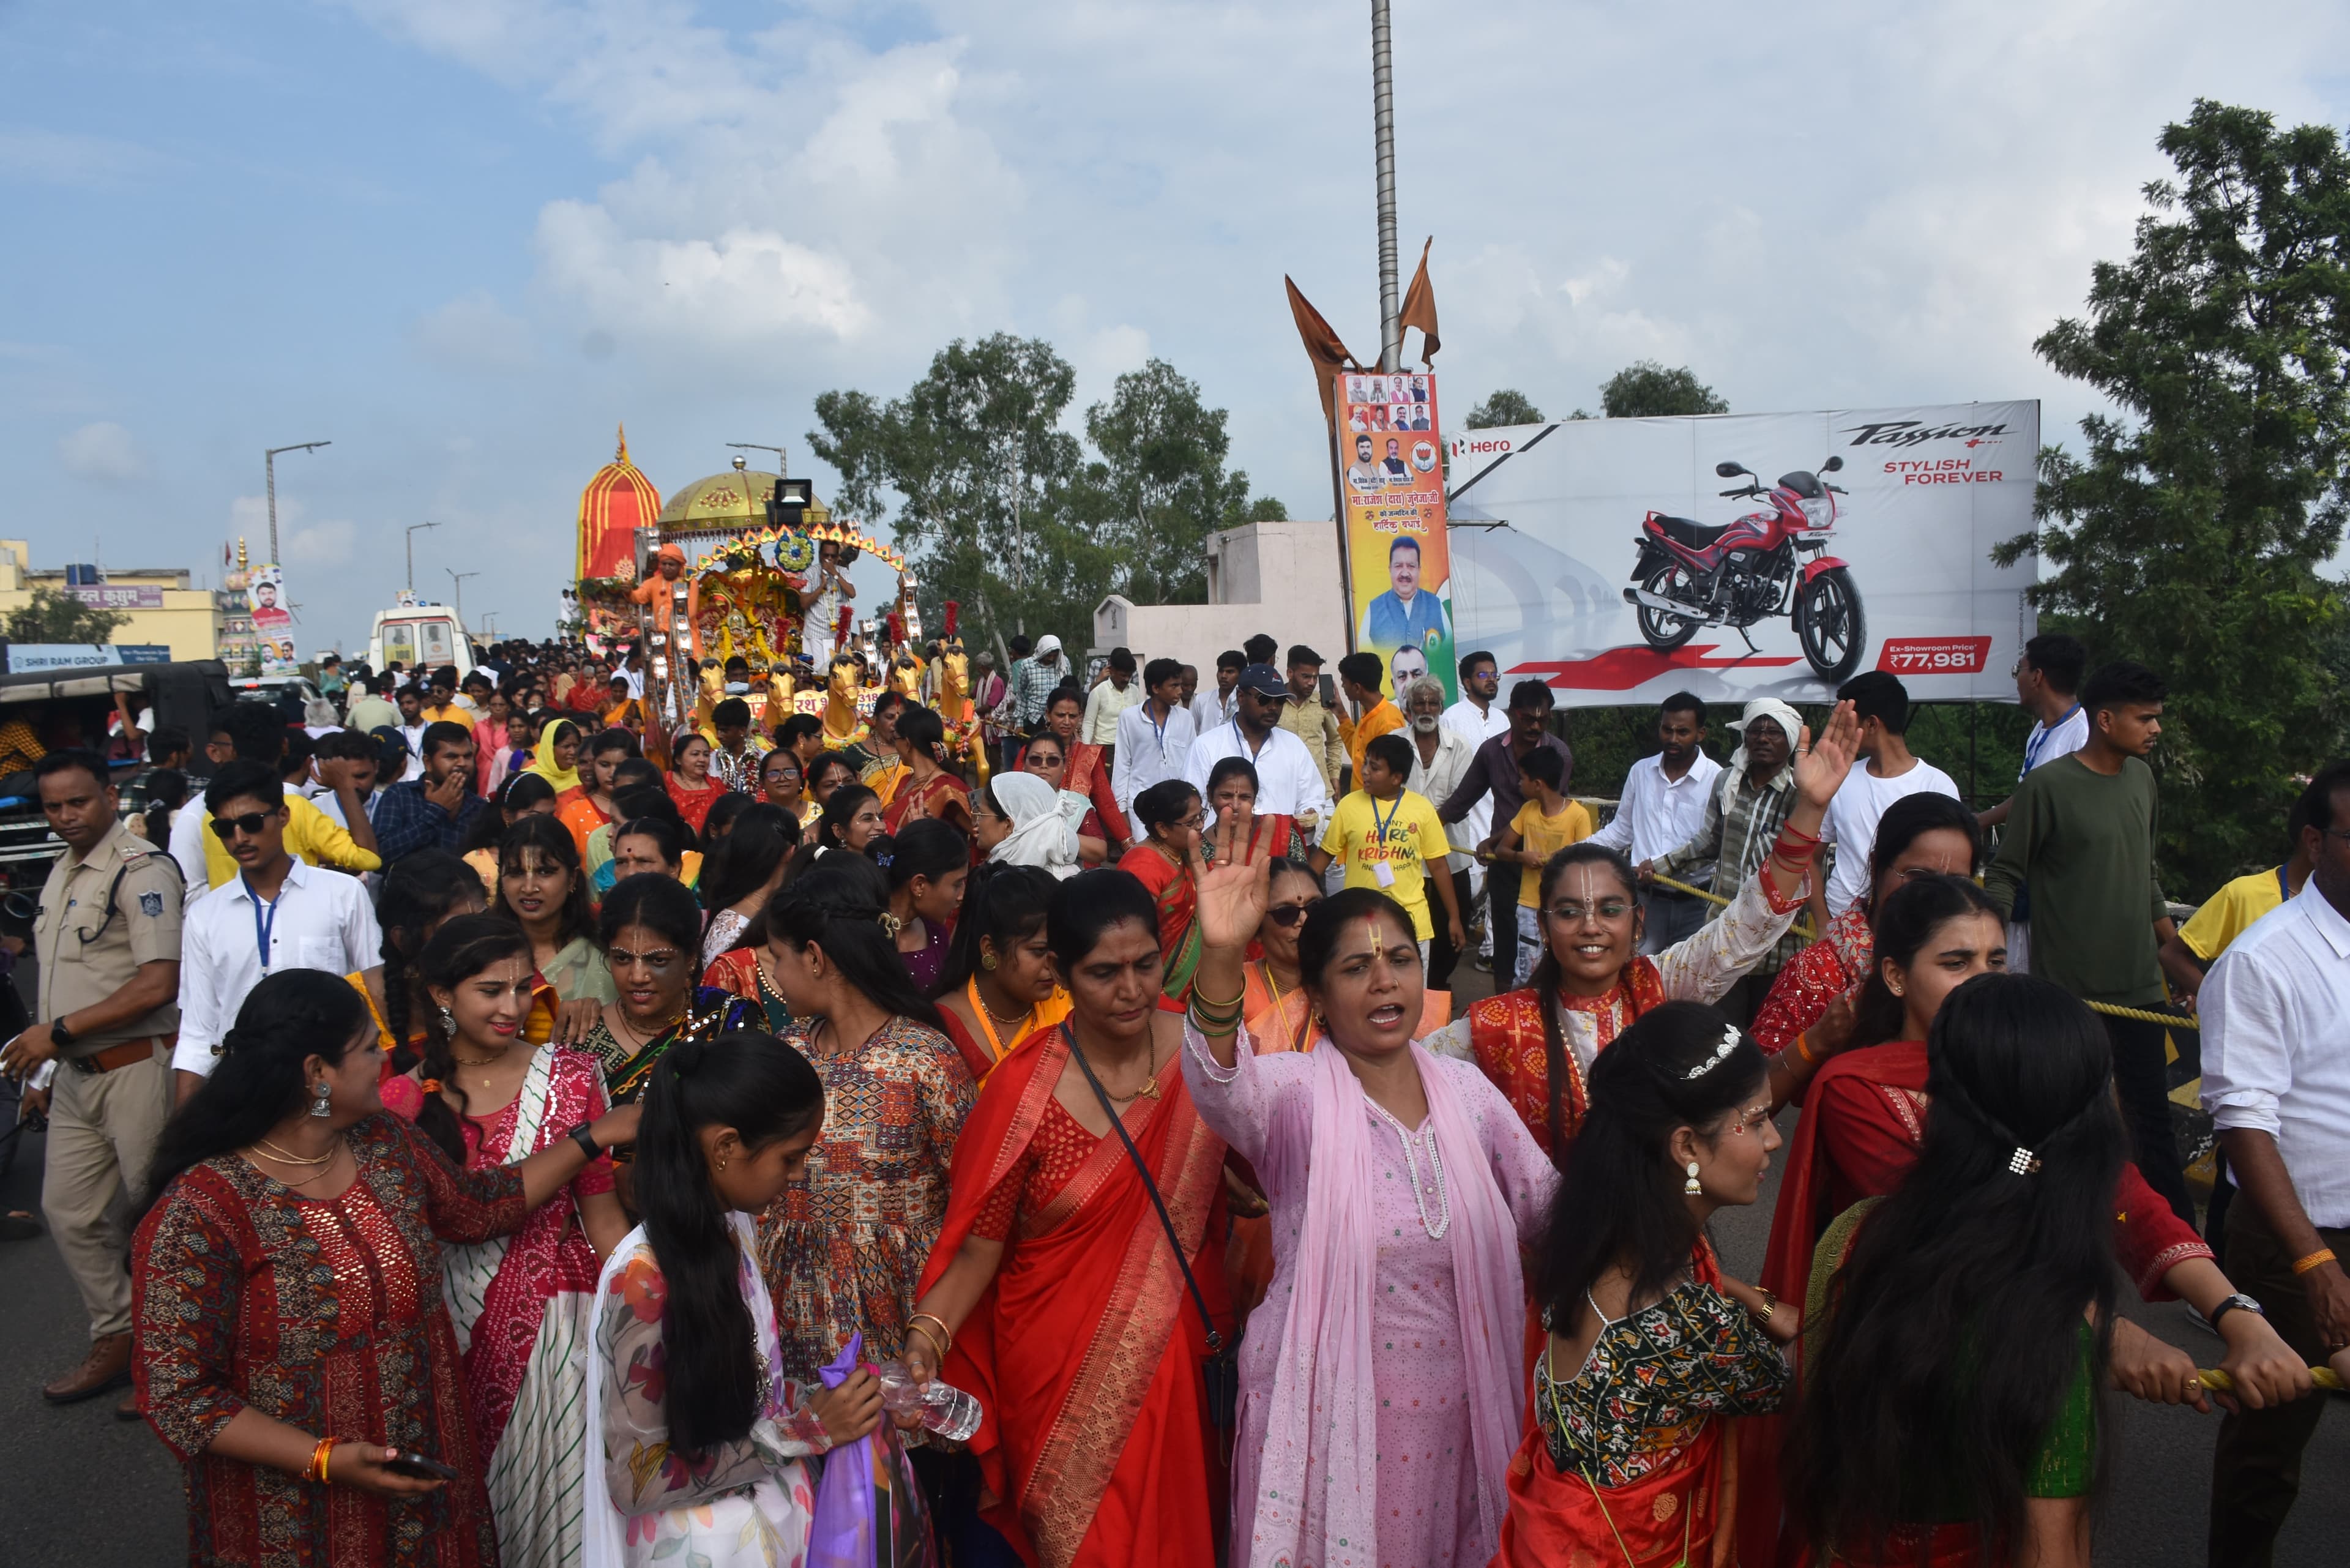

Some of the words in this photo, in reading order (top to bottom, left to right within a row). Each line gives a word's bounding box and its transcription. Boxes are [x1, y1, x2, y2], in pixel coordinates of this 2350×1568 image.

[1837, 421, 2017, 447] Passion
[1471, 440, 1510, 452] Hero
[1884, 459, 1970, 472] STYLISH
[1905, 471, 2002, 485] FOREVER
[1373, 519, 1398, 533] हार्दिक
[26, 657, 48, 666] SHRI
[51, 657, 72, 666] RAM
[75, 656, 108, 665] GROUP
[1890, 652, 1975, 670] ₹77,981
[1358, 846, 1416, 862] KRISHNA
